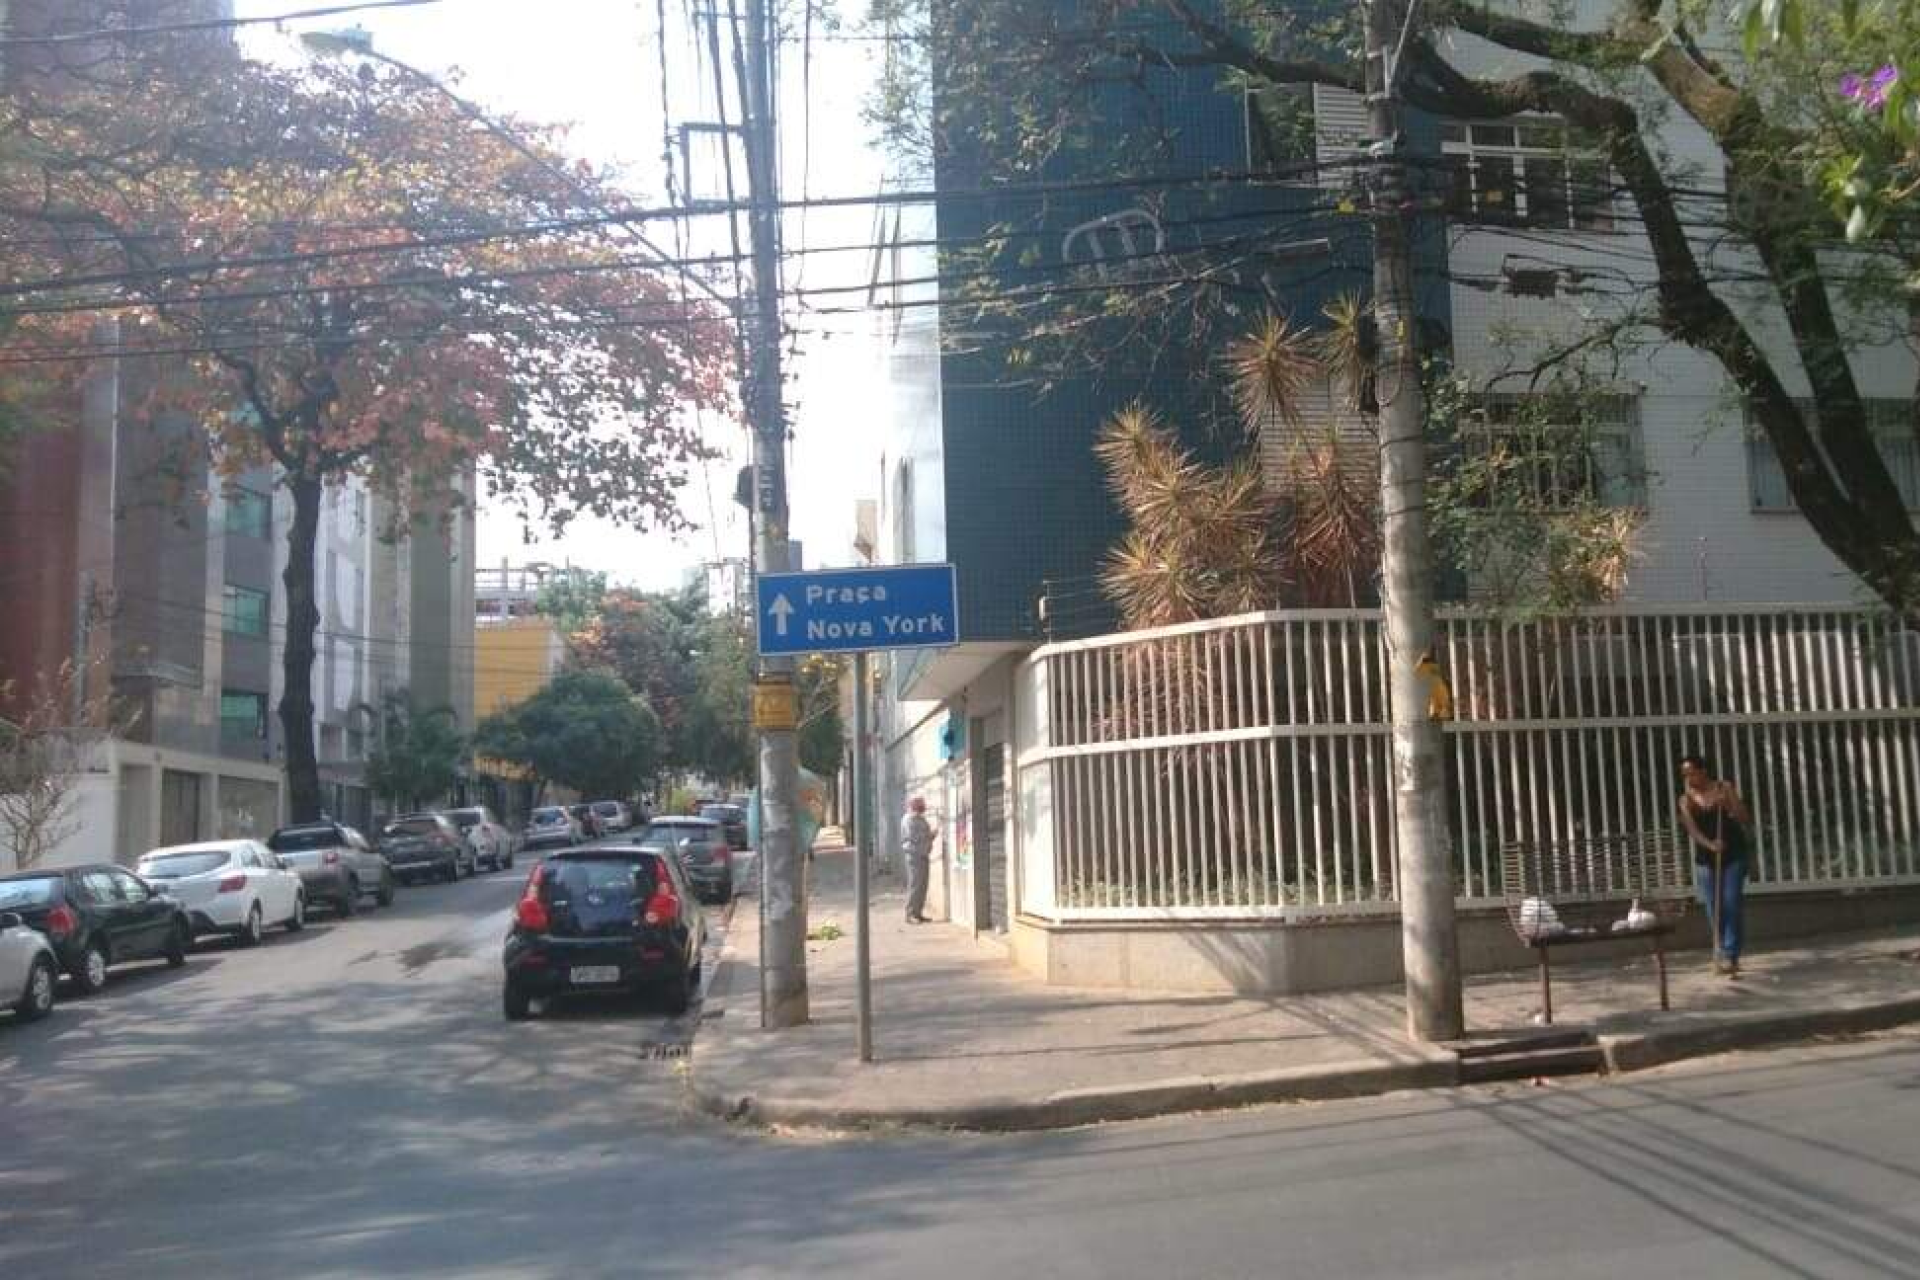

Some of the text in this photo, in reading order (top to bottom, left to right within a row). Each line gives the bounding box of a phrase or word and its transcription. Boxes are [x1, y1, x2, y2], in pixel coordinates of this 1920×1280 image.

[807, 585, 886, 605] Praça
[807, 613, 945, 640] Nova York
